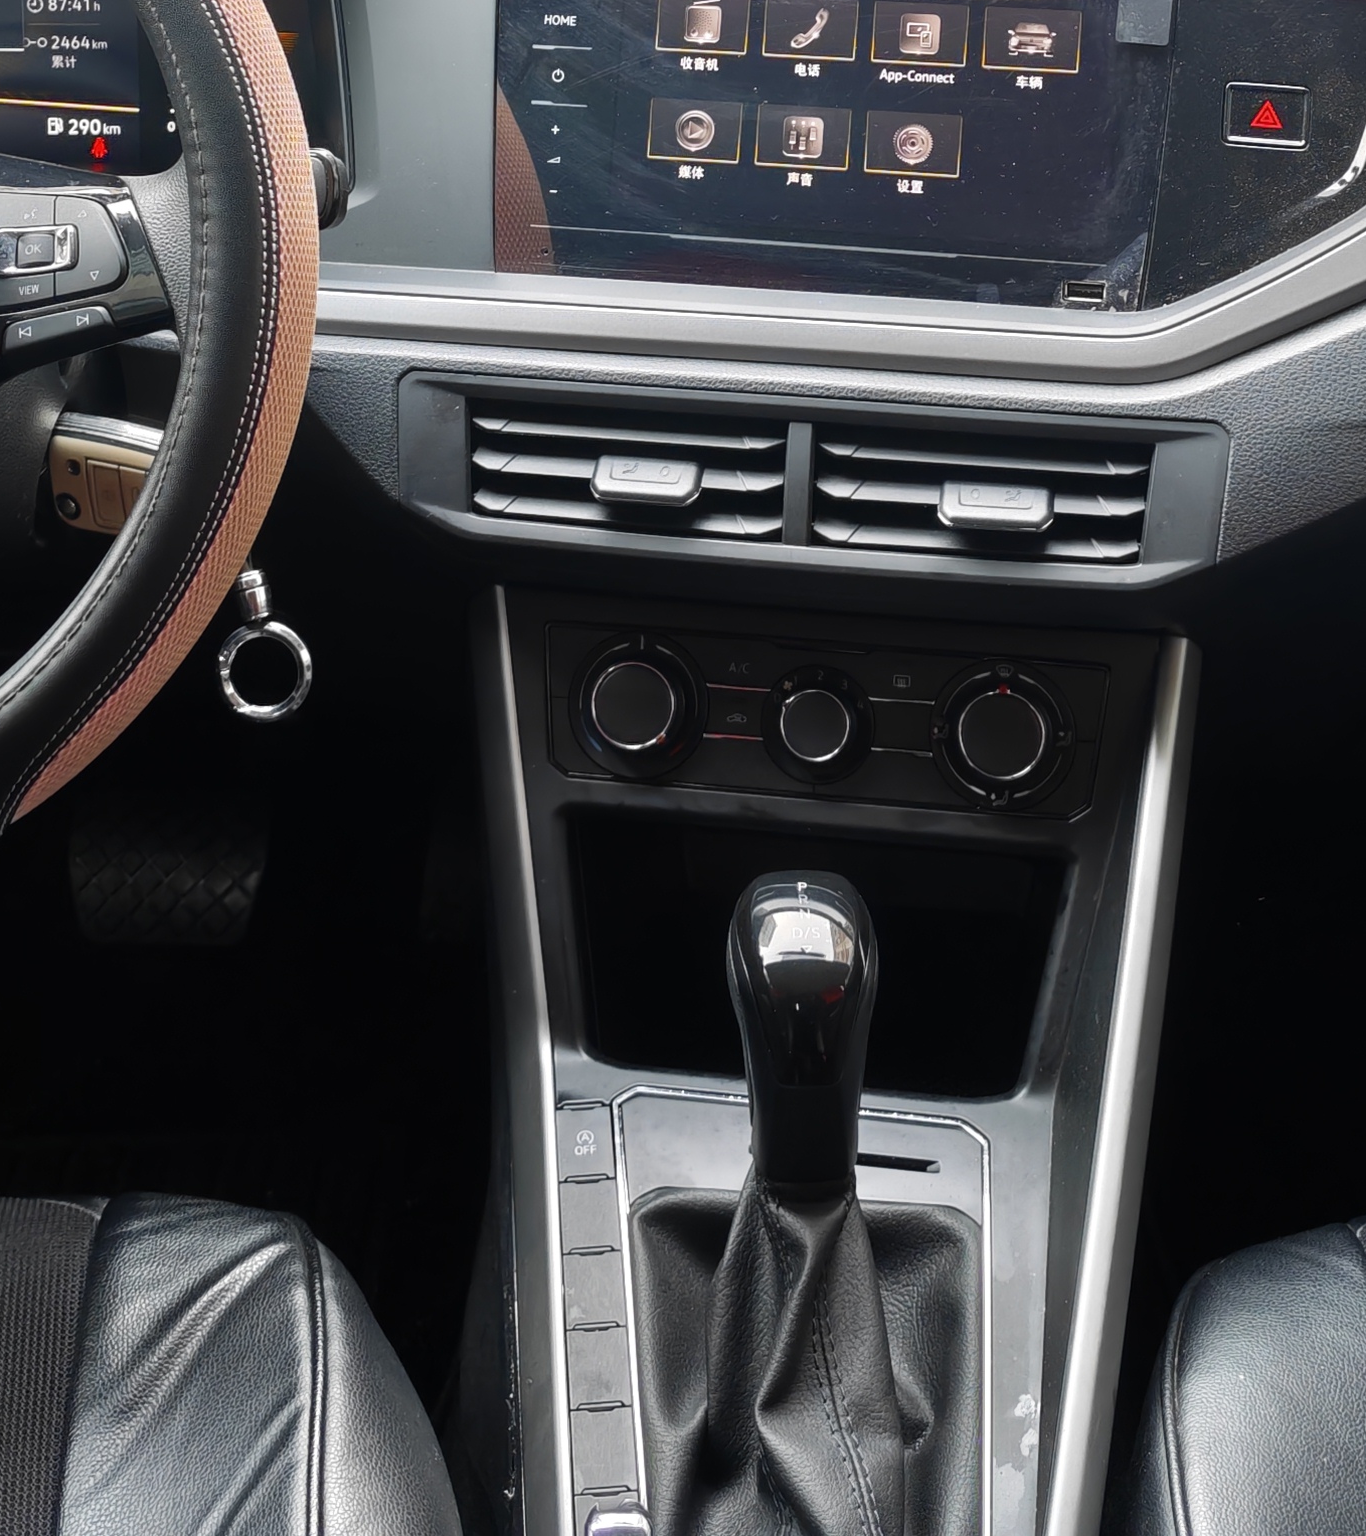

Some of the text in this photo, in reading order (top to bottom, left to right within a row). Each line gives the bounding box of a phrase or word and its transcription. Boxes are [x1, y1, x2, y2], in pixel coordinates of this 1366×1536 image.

[544, 14, 577, 26] HOME
[51, 55, 77, 68] 累计
[680, 56, 719, 72] 收音机
[794, 63, 821, 78] 电话
[879, 68, 955, 85] App-Connect
[1015, 75, 1043, 90] 车辆
[678, 165, 705, 180] 媒体
[786, 172, 813, 187] 声音
[897, 179, 924, 194] 设置
[25, 244, 42, 255] OK
[19, 284, 39, 296] VIEW
[797, 881, 807, 892] P
[798, 894, 809, 905] R
[799, 908, 811, 919] N
[792, 927, 821, 939] D/S
[574, 1145, 597, 1156] OFF
